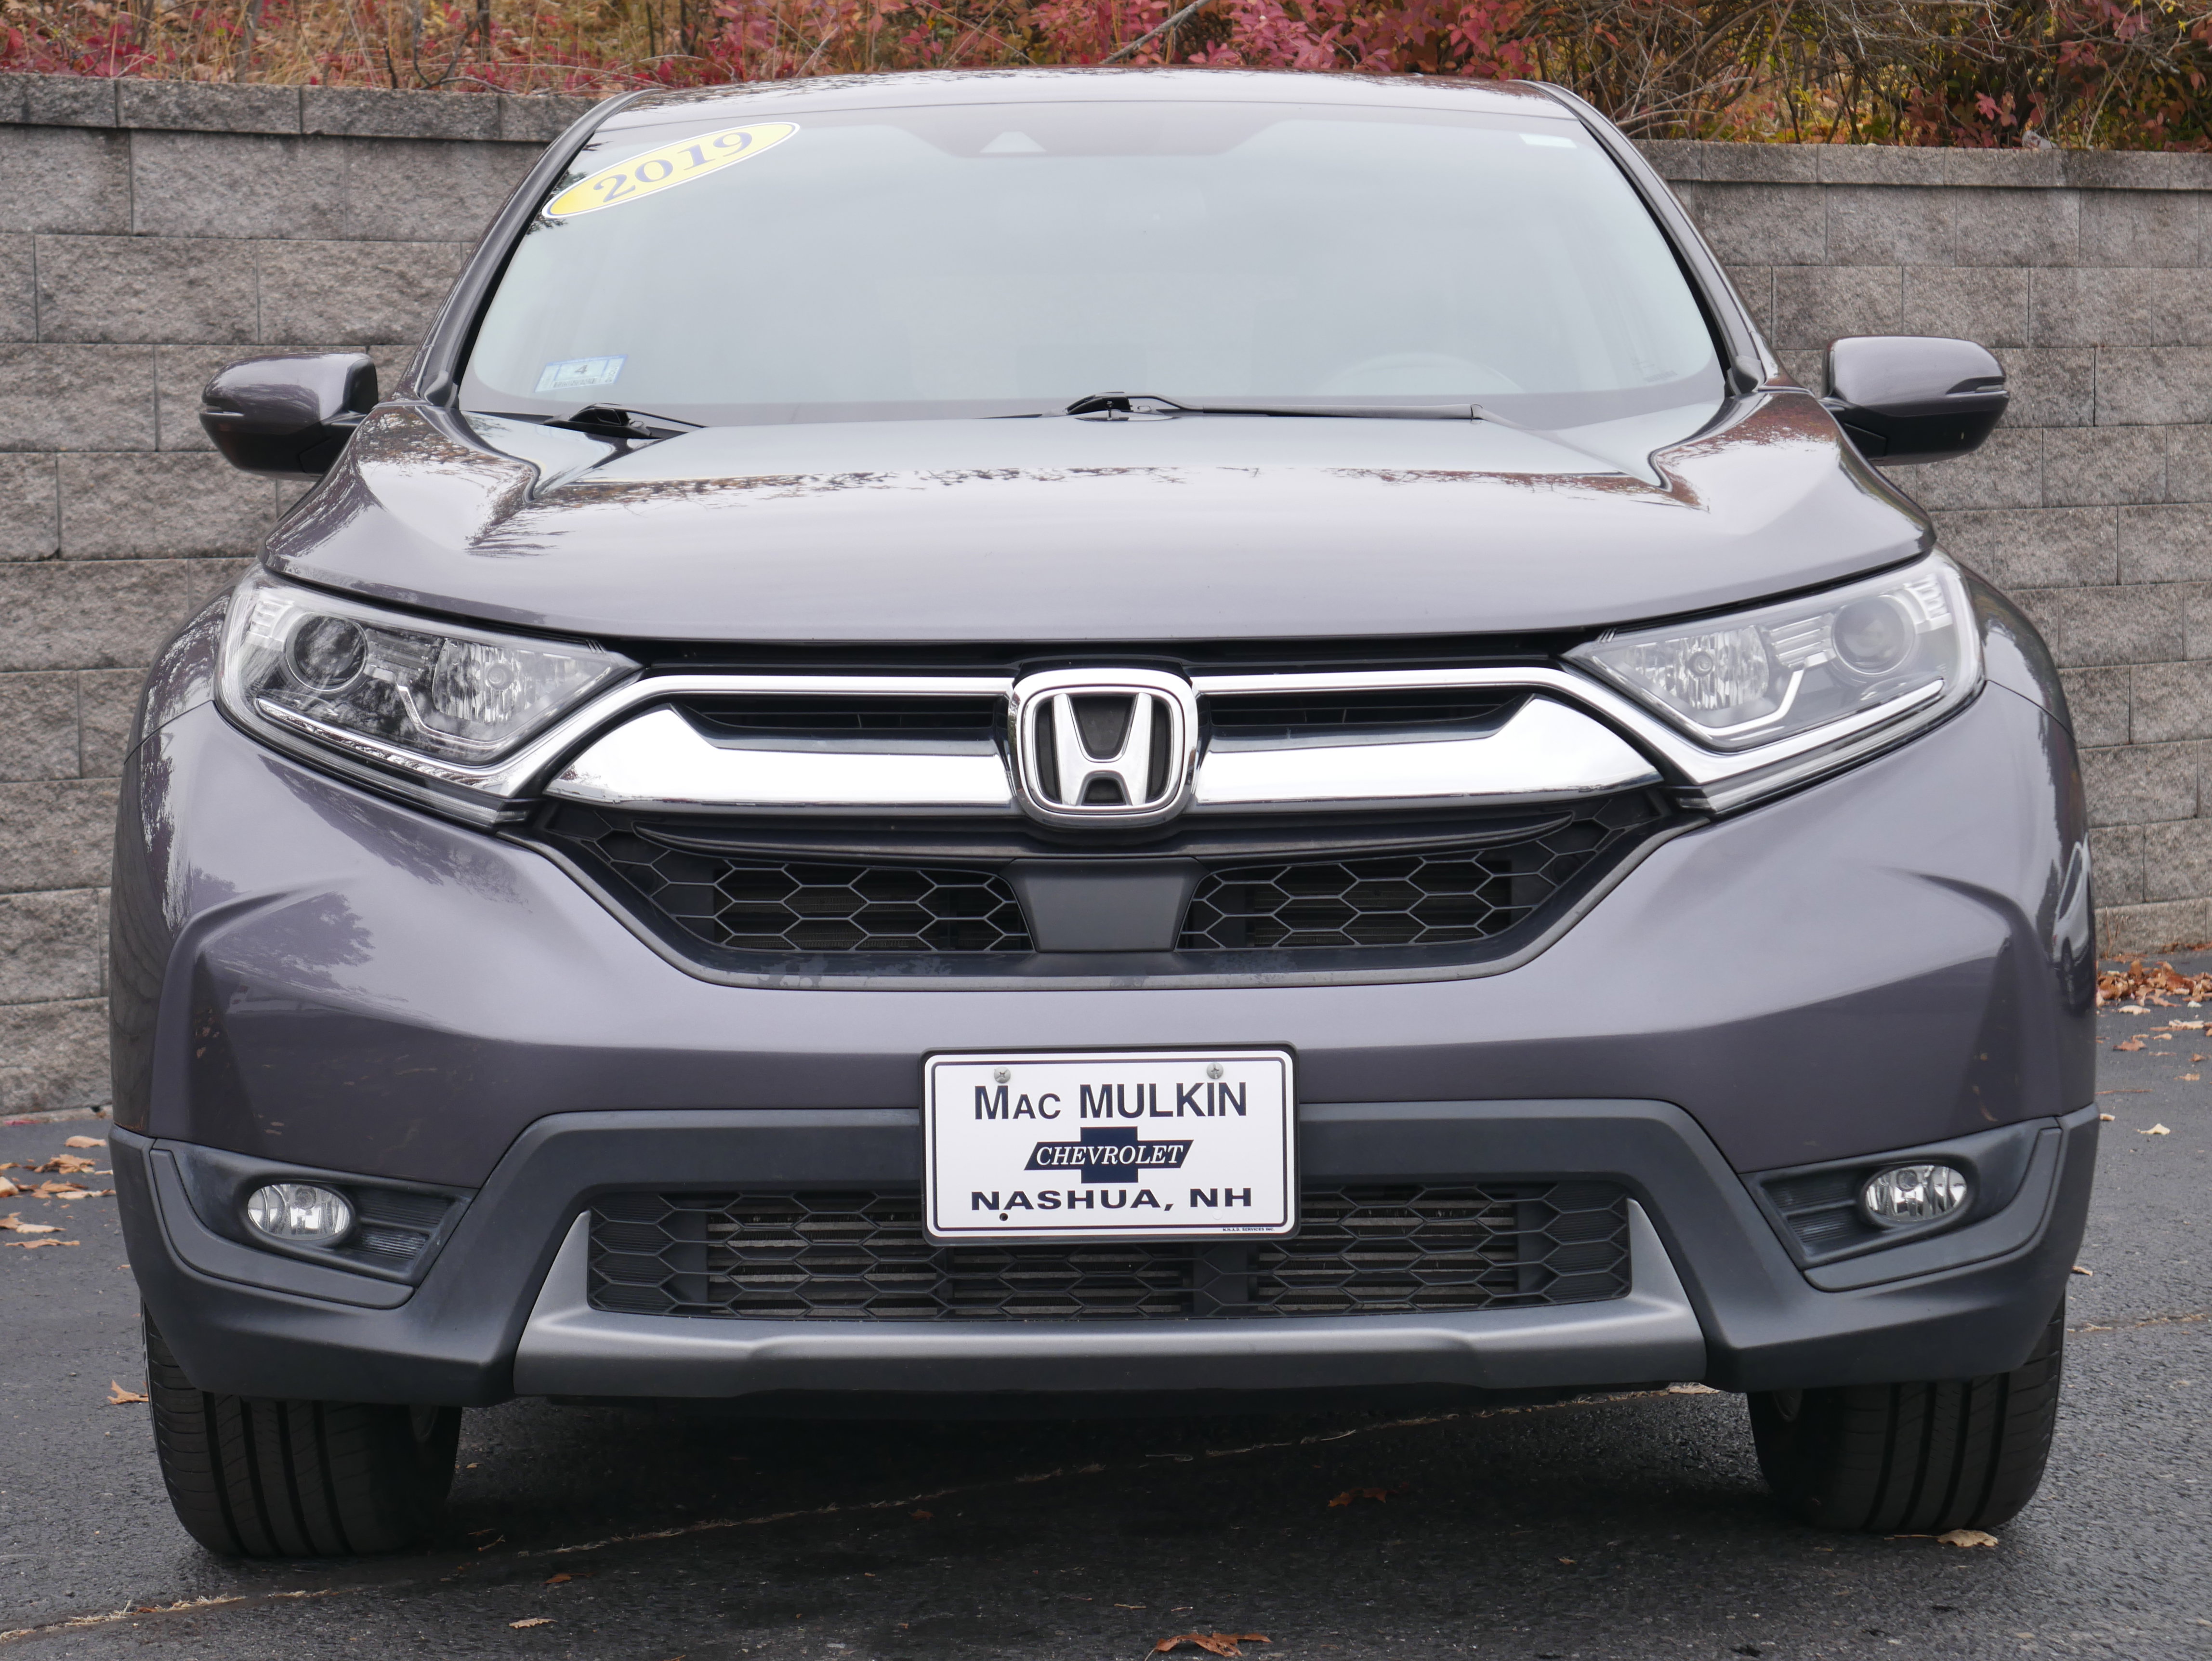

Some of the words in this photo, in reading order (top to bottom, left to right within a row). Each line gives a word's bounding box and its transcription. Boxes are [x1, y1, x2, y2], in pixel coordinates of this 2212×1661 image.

[593, 132, 752, 202] 2019
[574, 365, 588, 374] 4
[1080, 1082, 1246, 1118] MULKIN
[1036, 1145, 1184, 1165] CHEVROLET
[971, 1189, 1174, 1212] NASHUA,
[1190, 1187, 1251, 1208] NH
